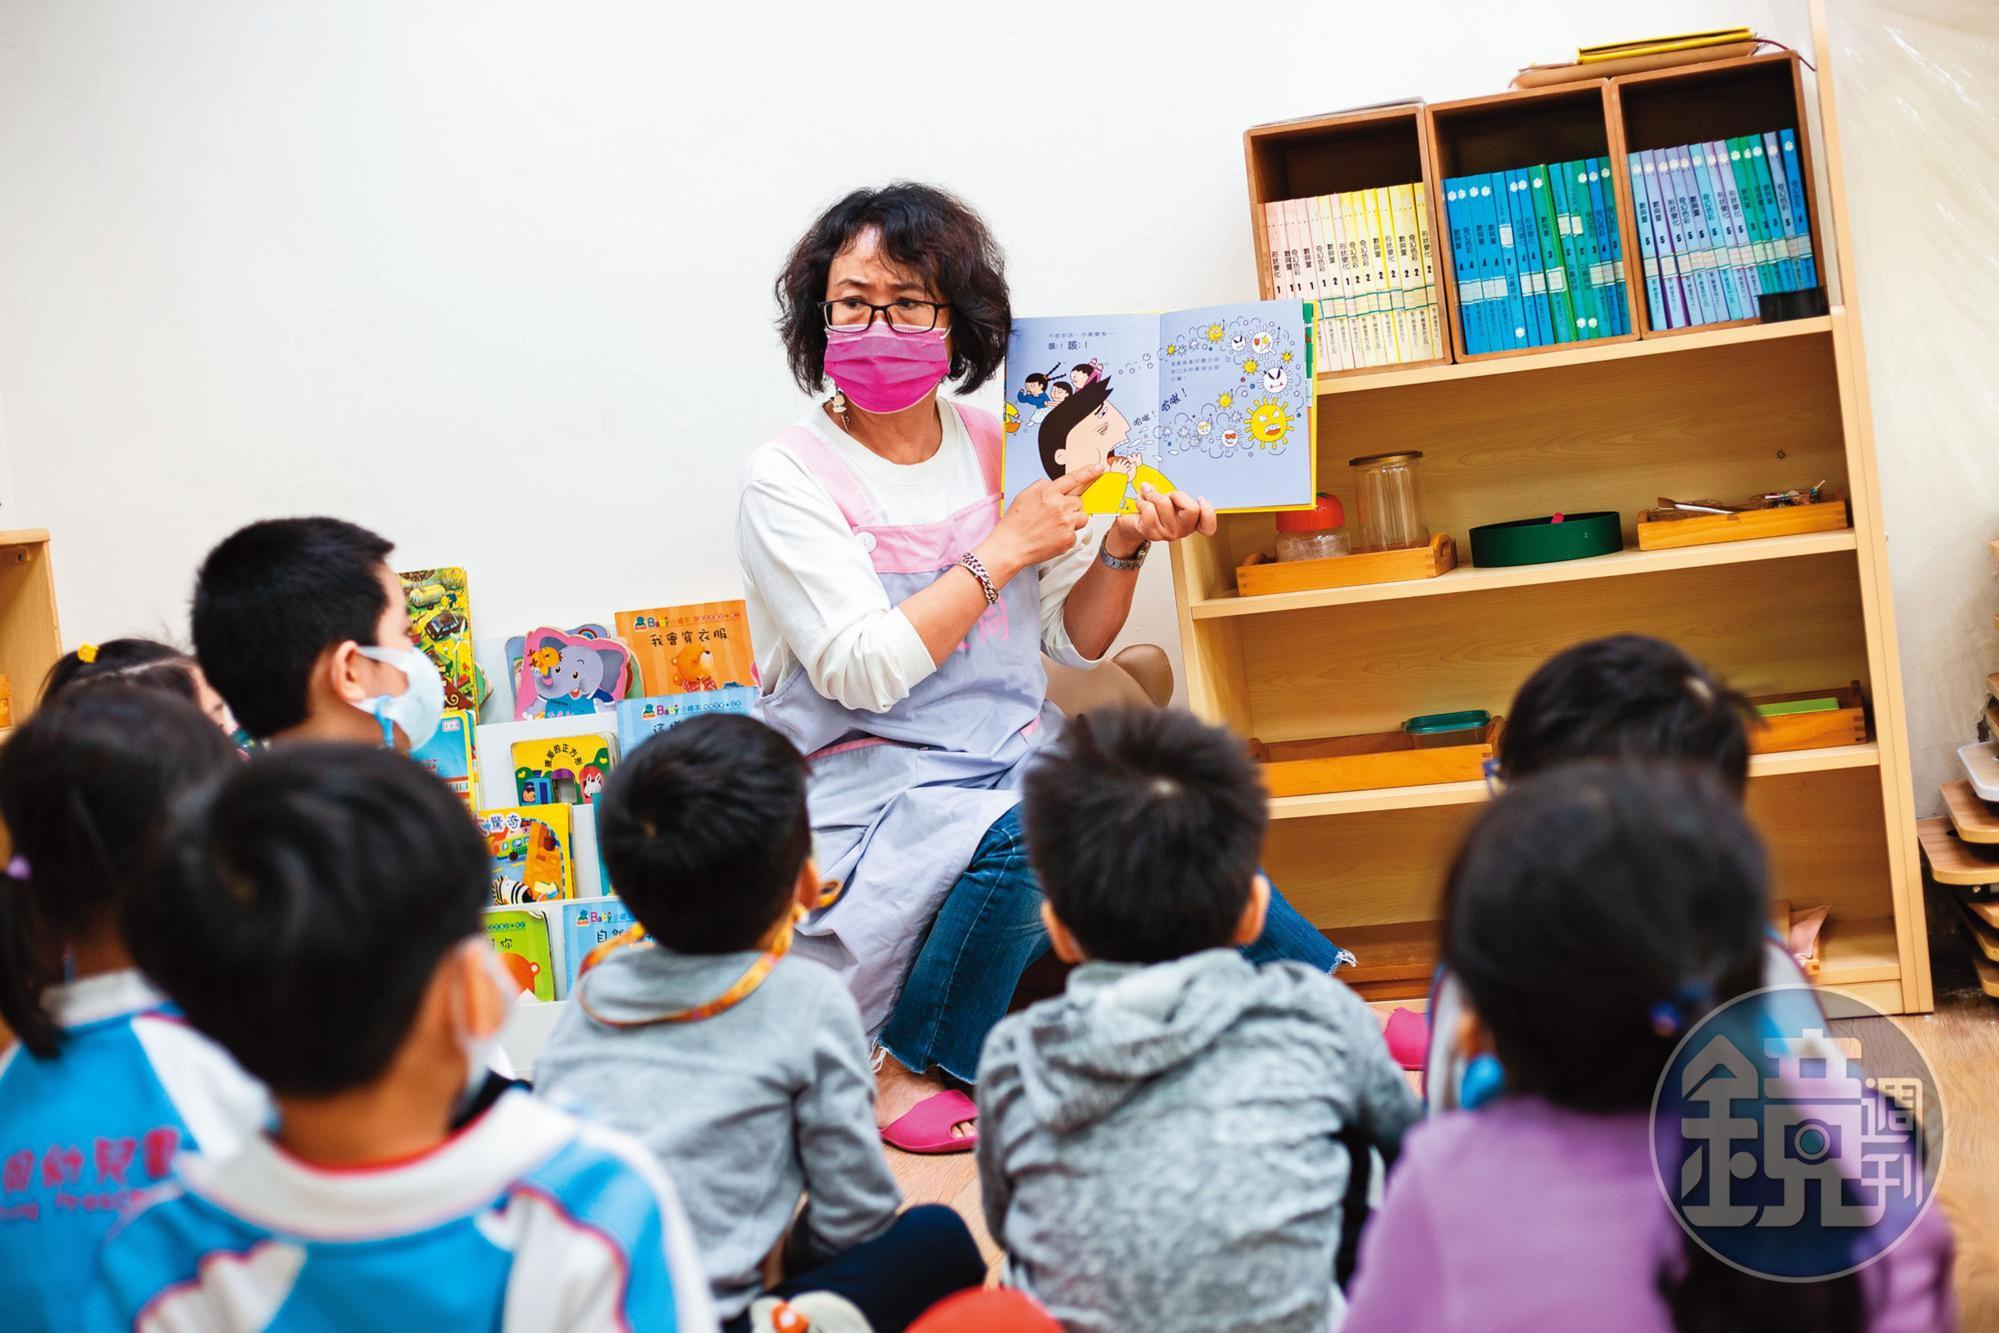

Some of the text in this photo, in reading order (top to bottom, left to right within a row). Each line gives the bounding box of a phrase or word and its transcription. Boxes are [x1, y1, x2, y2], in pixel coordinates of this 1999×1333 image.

[650, 628, 728, 647] 我會穿衣服
[656, 704, 679, 716] Baby
[590, 911, 612, 923] Baby
